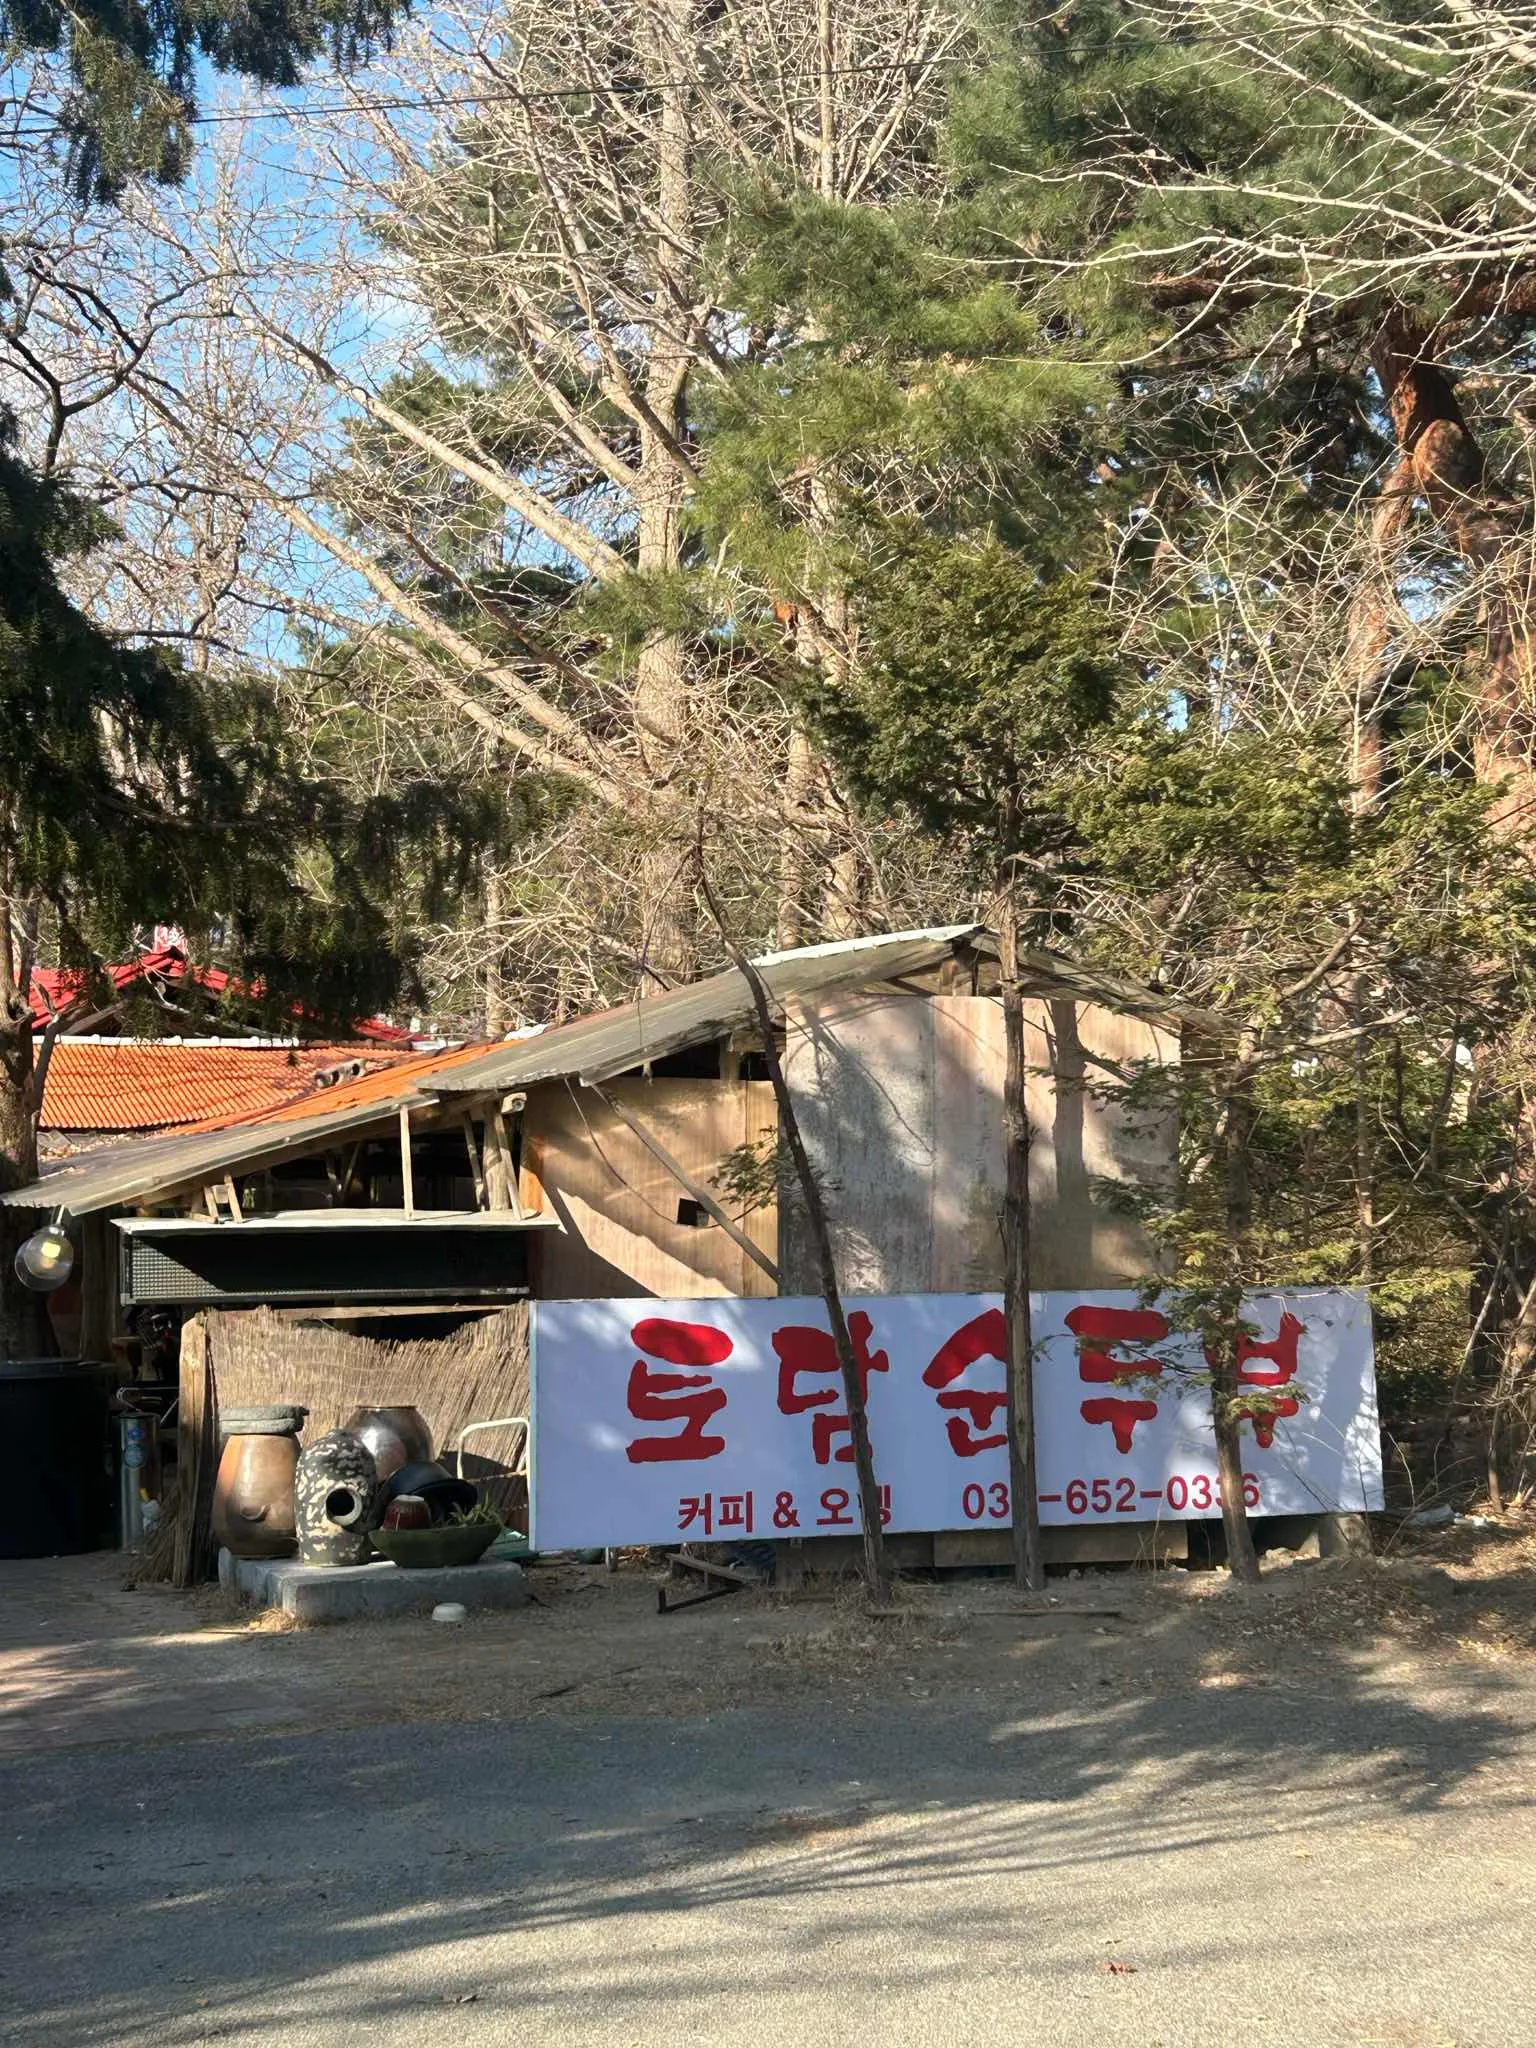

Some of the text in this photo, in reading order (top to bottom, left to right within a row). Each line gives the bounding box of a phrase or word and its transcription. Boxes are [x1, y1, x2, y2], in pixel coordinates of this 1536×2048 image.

[627, 1306, 1303, 1463] 토담순두부
[677, 1491, 753, 1535] 커피
[773, 1491, 801, 1528] &
[962, 1473, 1260, 1519] 03-652-036
